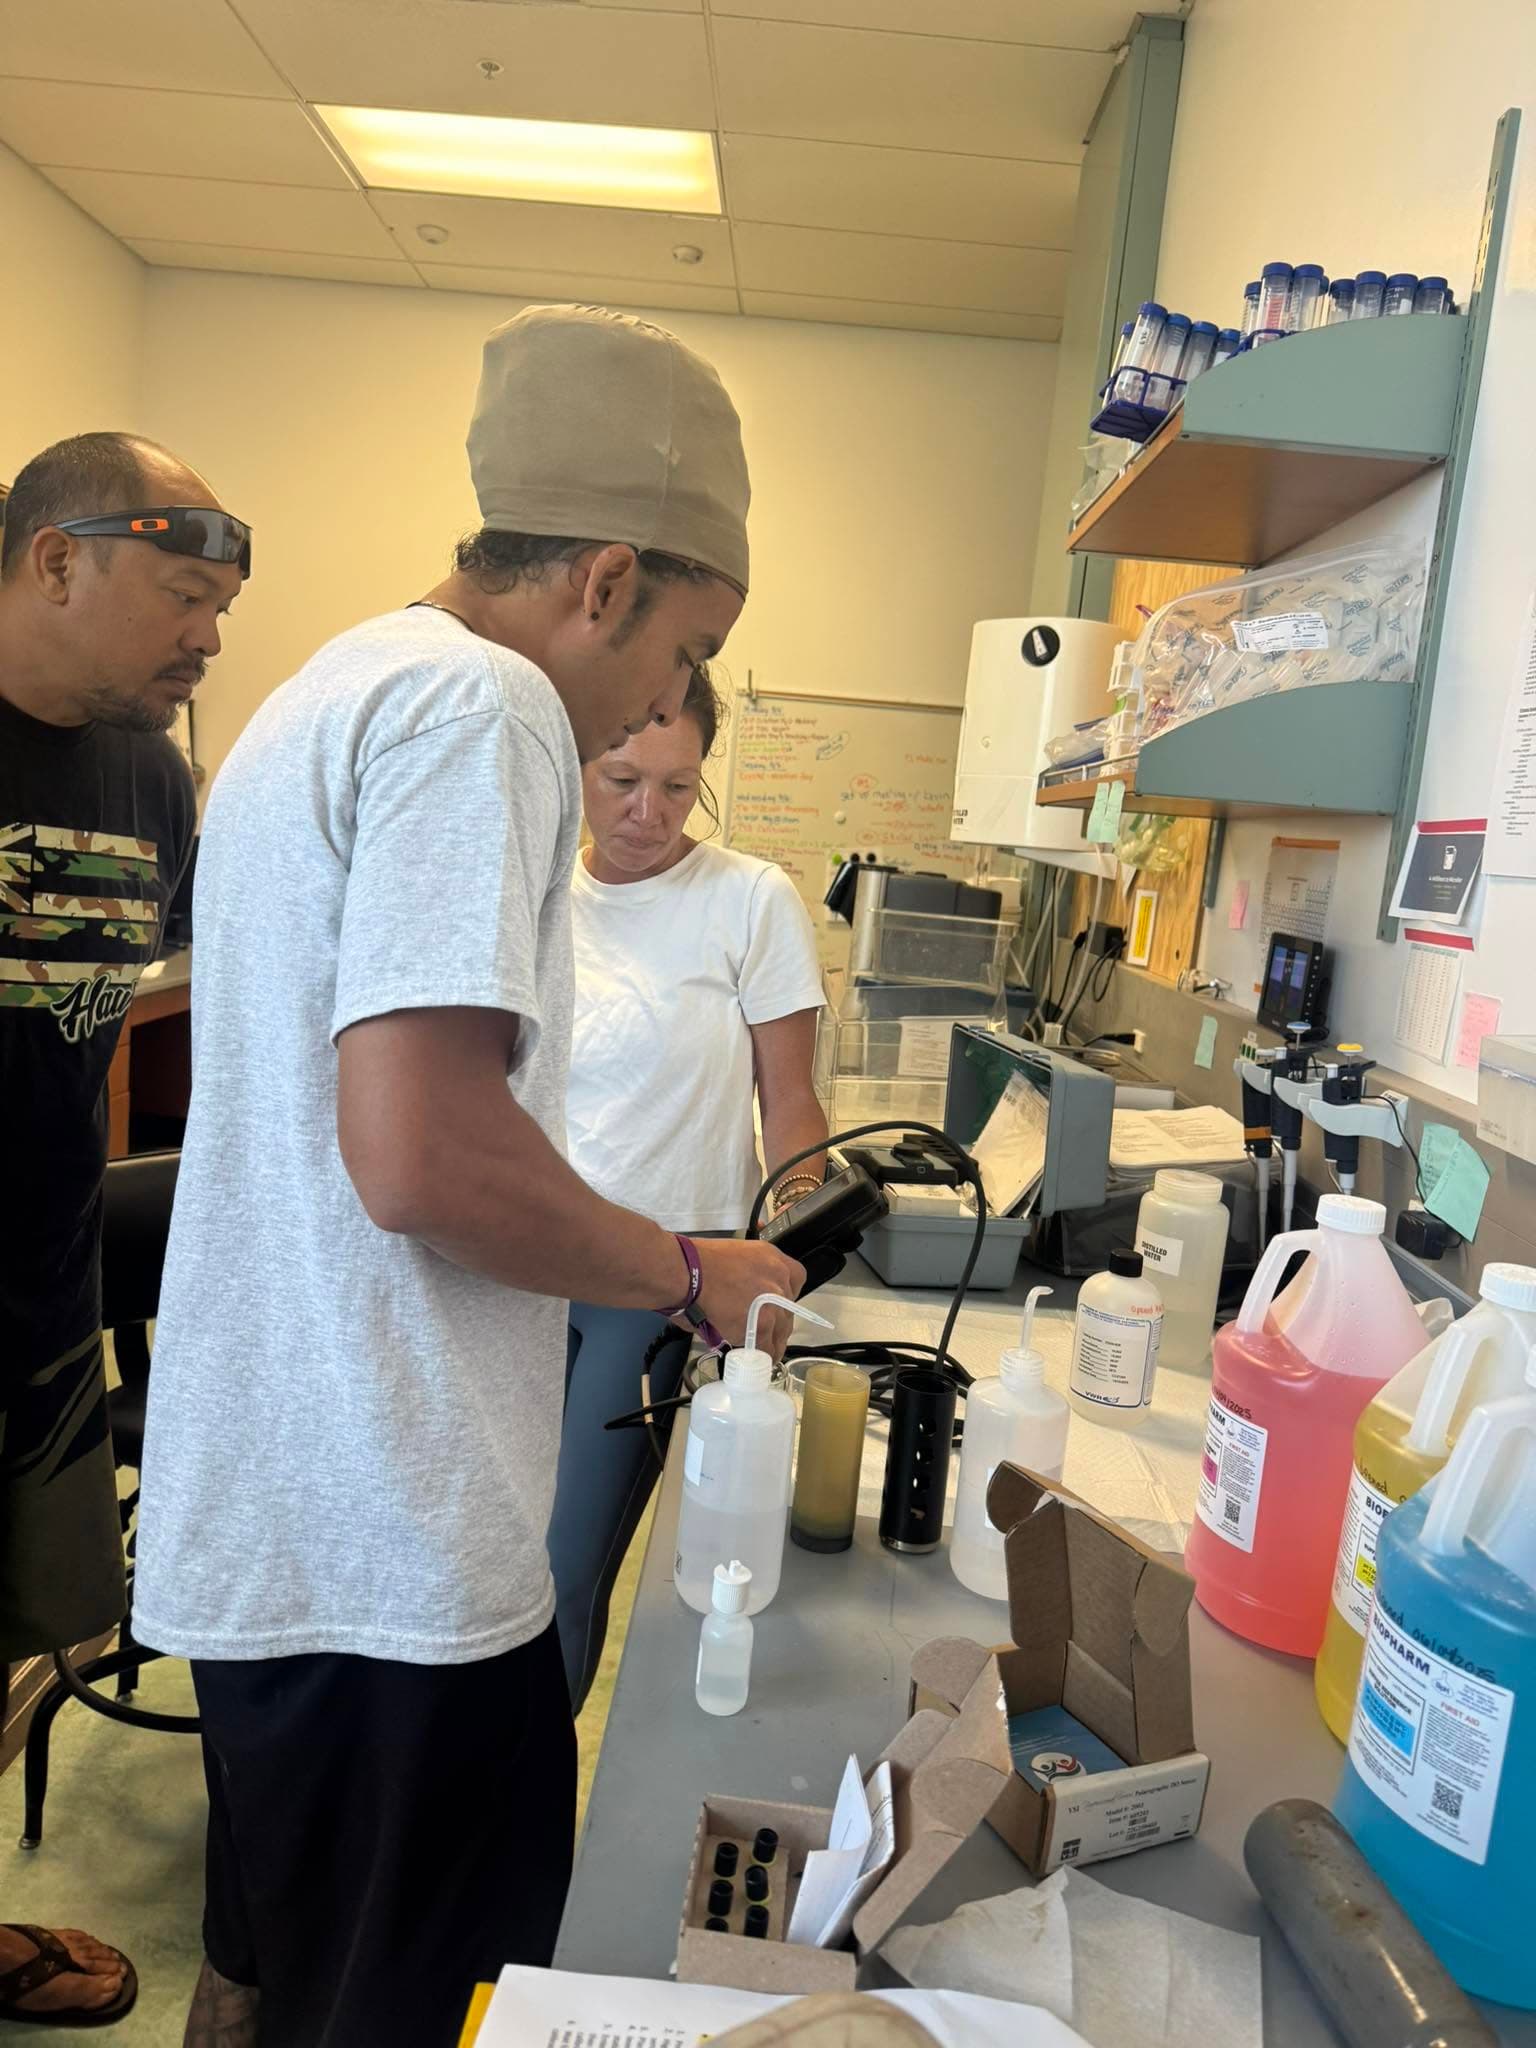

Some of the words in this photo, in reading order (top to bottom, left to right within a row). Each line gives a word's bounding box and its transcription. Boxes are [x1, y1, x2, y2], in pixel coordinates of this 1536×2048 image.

[50, 973, 139, 1044] Haw
[1141, 1240, 1168, 1256] DISTILLED
[1143, 1249, 1162, 1262] WATER
[1373, 1612, 1431, 1676] BIOPHARM
[1440, 1701, 1463, 1719] FIRST
[1464, 1714, 1481, 1727] AID
